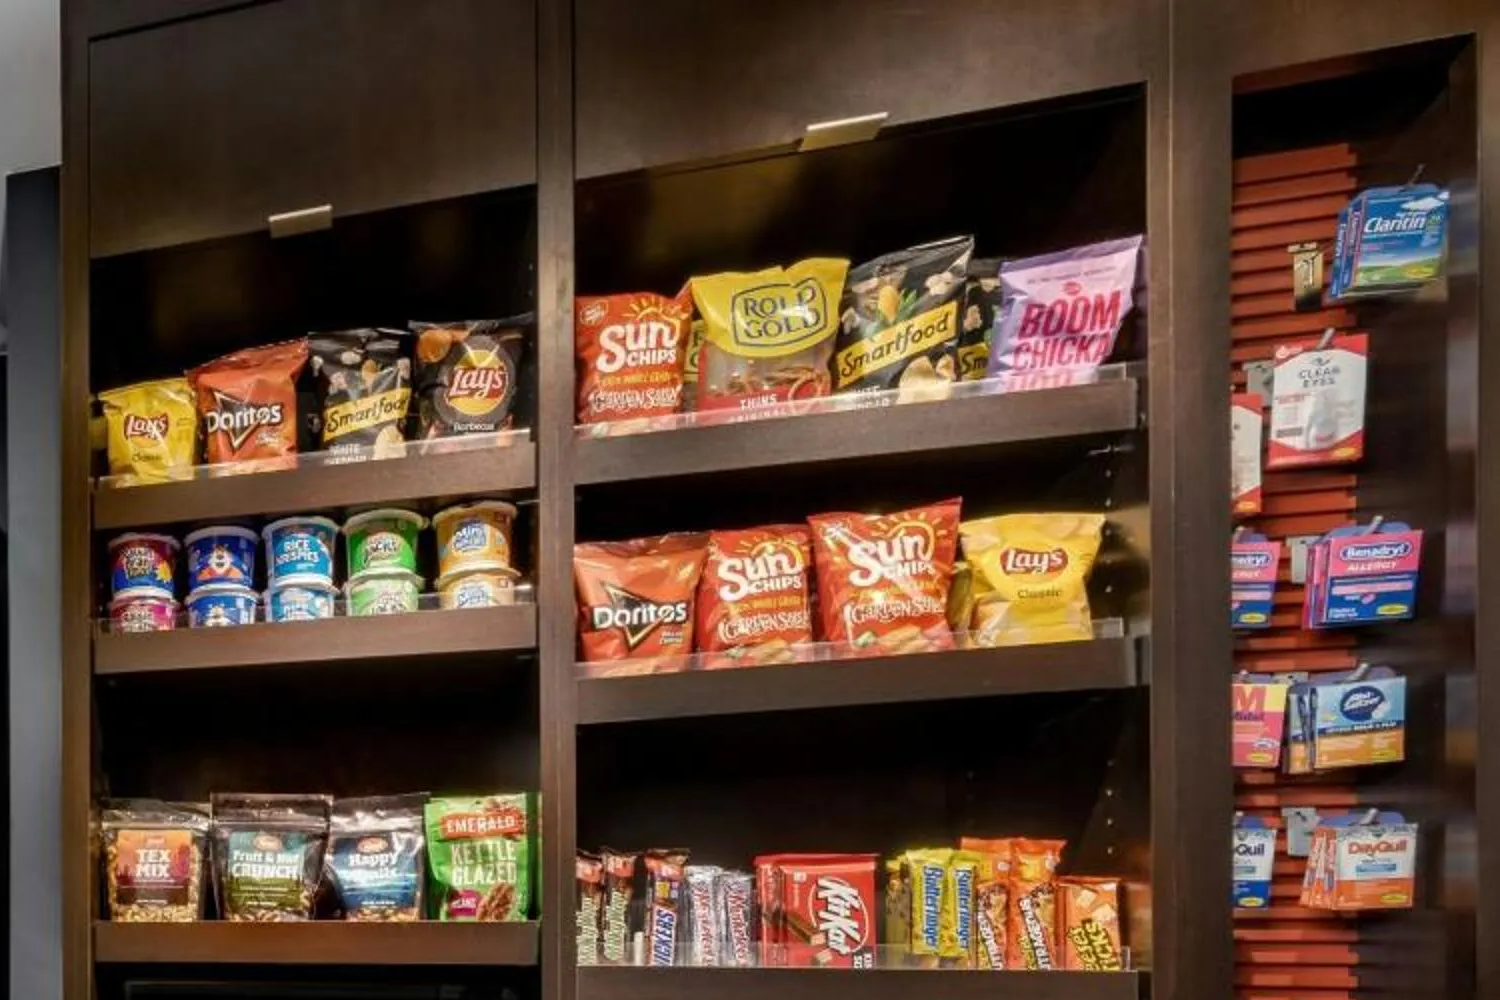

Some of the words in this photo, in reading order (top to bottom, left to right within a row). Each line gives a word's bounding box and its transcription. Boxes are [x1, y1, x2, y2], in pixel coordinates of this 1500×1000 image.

[743, 308, 821, 340] GOLD
[1017, 288, 1123, 339] BOOM
[841, 311, 952, 377] Smartfood
[627, 349, 677, 367] CHIPS
[206, 404, 282, 433] Doritos
[750, 575, 802, 593] CHIPS
[592, 601, 687, 629] Doritos
[446, 815, 517, 834] EMERALD
[136, 849, 172, 863] TEX
[1235, 842, 1265, 858] Quil
[135, 863, 171, 878] MIX
[451, 862, 518, 887] GLAZED
[924, 865, 944, 949] Butterfinger
[652, 909, 677, 966] ICKERS
